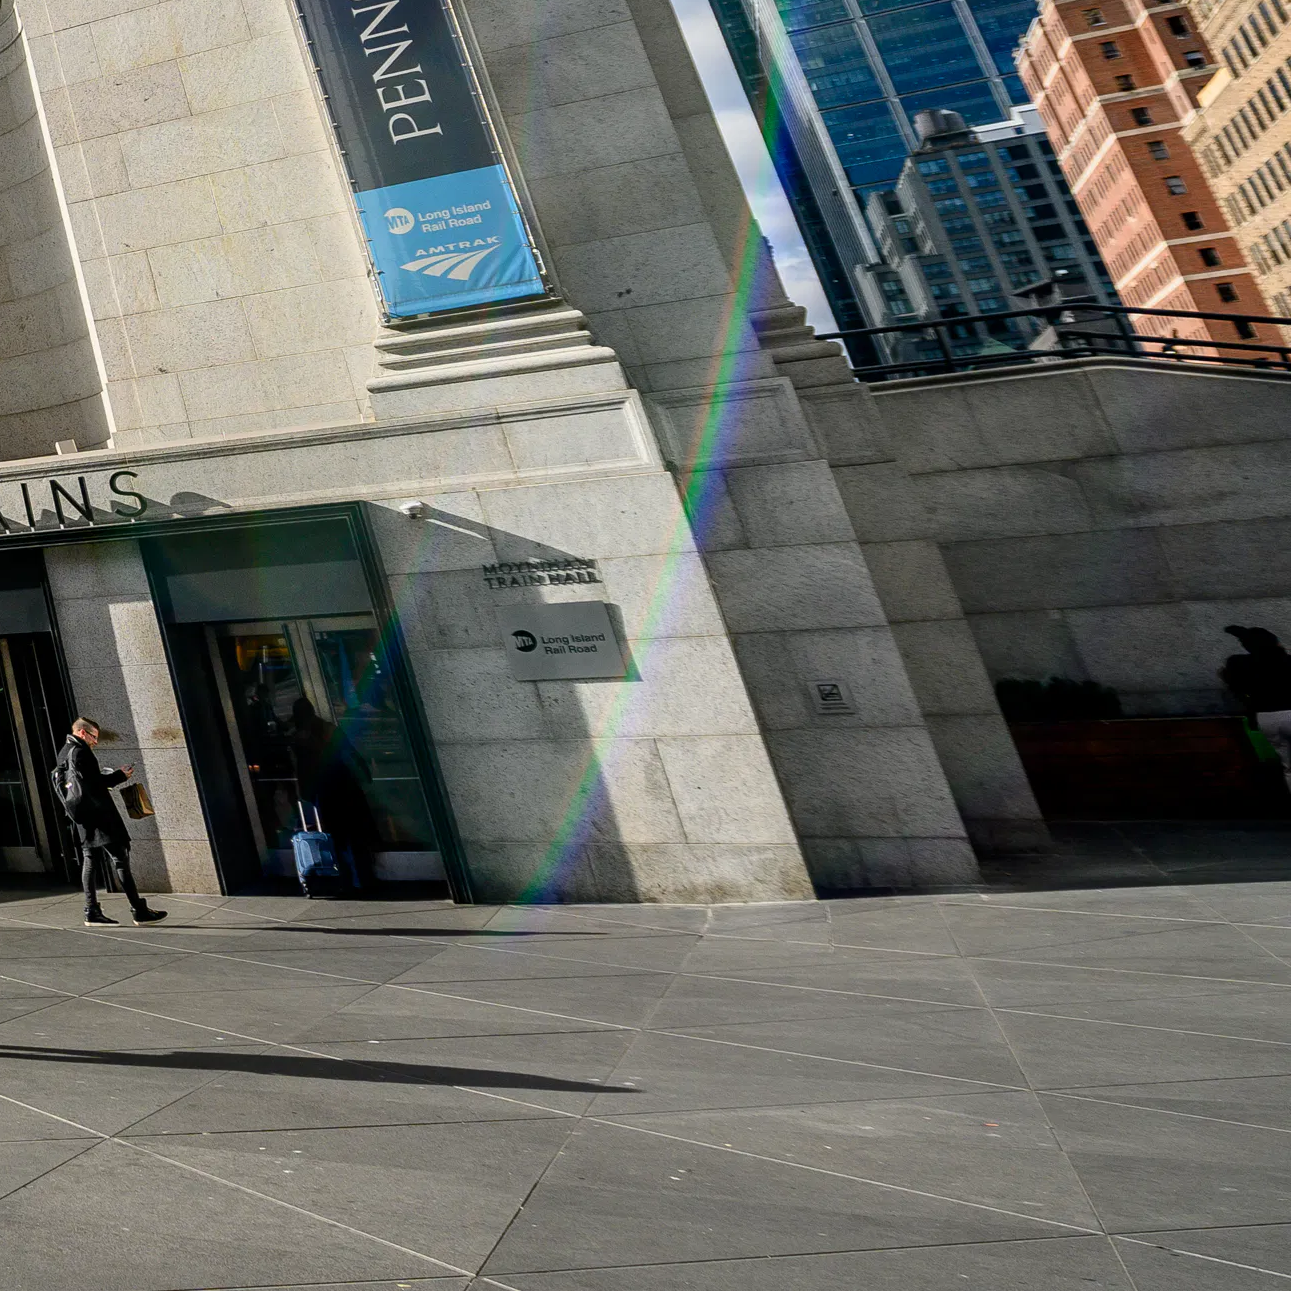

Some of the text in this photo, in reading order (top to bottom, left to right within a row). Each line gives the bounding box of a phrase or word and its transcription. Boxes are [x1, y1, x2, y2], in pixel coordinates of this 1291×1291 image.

[418, 199, 491, 222] Long Island
[421, 214, 482, 233] Rail Road
[415, 235, 500, 256] AMTRAK
[481, 558, 597, 576] MOYNIHAN
[483, 570, 603, 589] TRAIN HALL
[540, 633, 606, 646] Long Island
[545, 644, 598, 655] Rail Road
